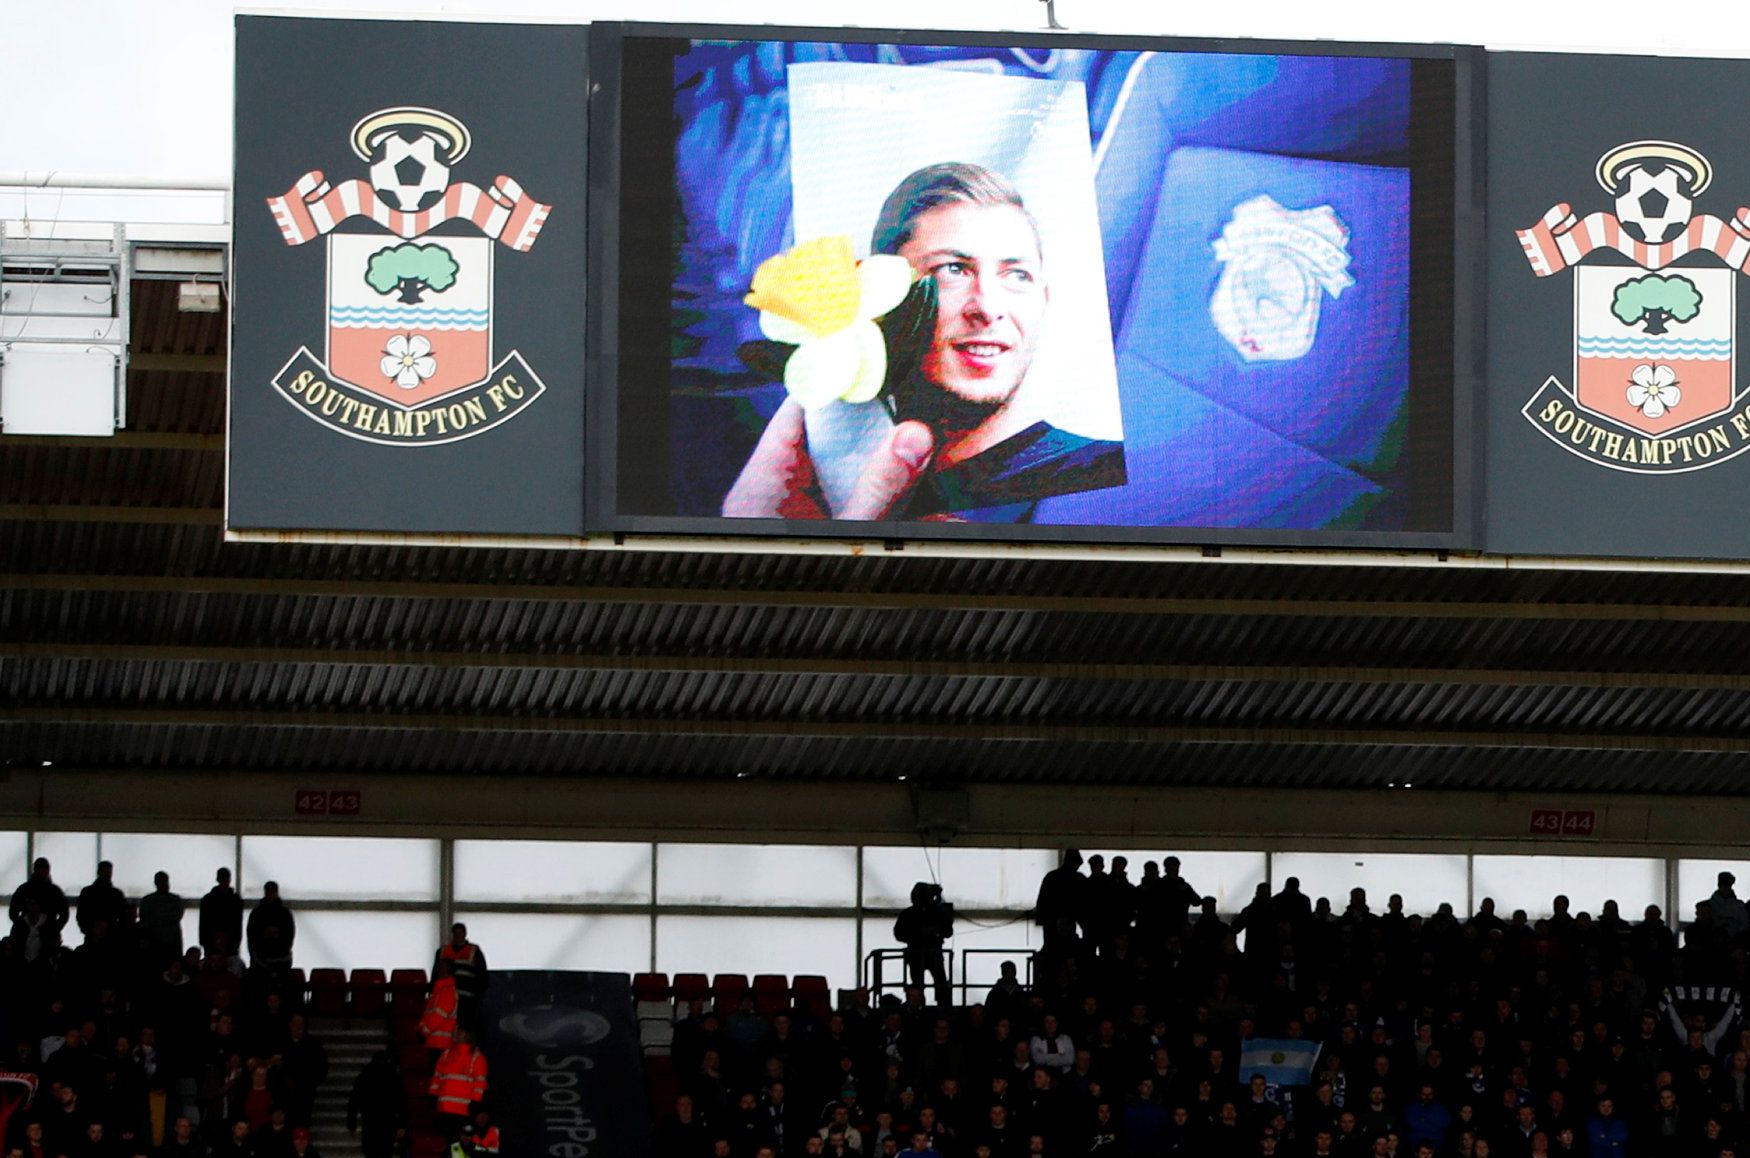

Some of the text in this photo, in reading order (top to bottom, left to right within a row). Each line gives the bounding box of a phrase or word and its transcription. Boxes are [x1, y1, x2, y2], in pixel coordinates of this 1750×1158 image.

[290, 369, 525, 436] SOUTHAMPTON FC
[1539, 399, 1731, 464] SOUTHAMPTON
[299, 795, 358, 810] 42 43
[1533, 814, 1592, 831] 43 44
